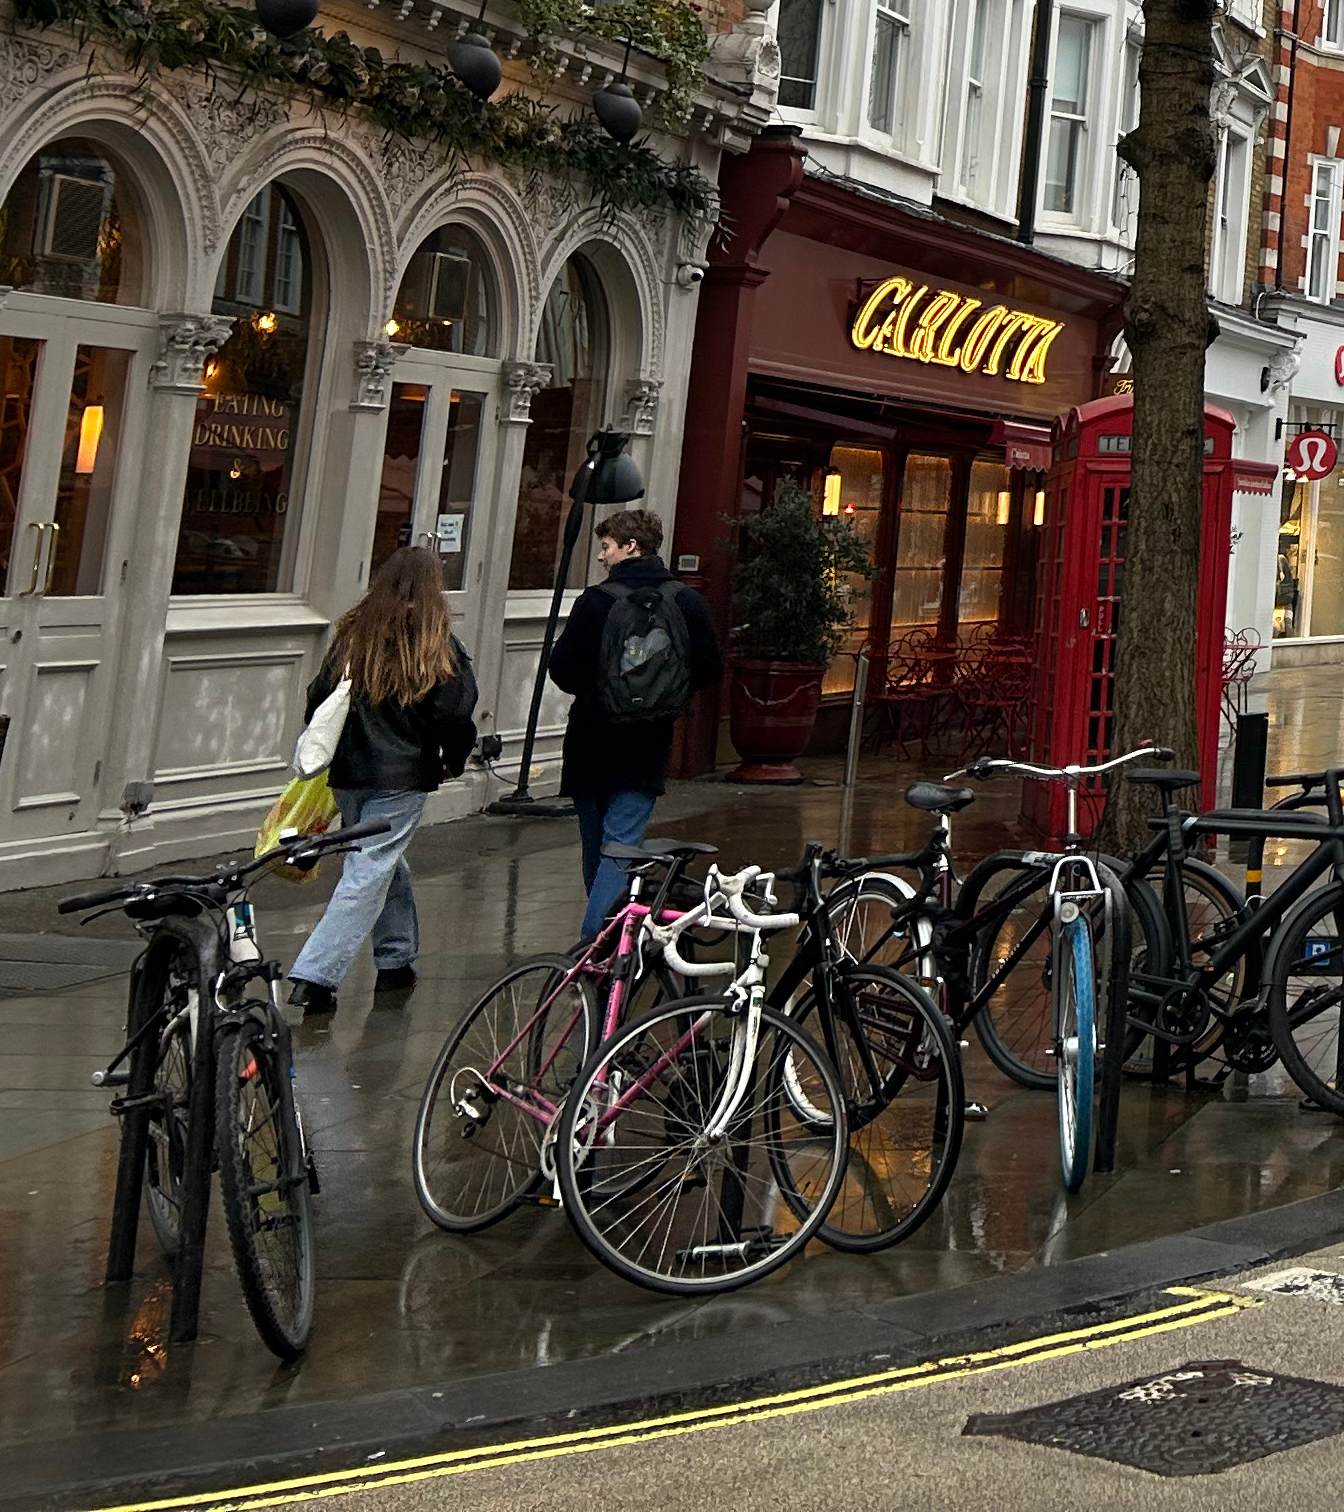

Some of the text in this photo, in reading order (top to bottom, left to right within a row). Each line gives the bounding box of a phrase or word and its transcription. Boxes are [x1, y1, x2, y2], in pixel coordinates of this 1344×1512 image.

[851, 276, 1065, 383] CARLOTTA
[214, 391, 284, 418] EATING
[194, 423, 289, 450] DRINKING
